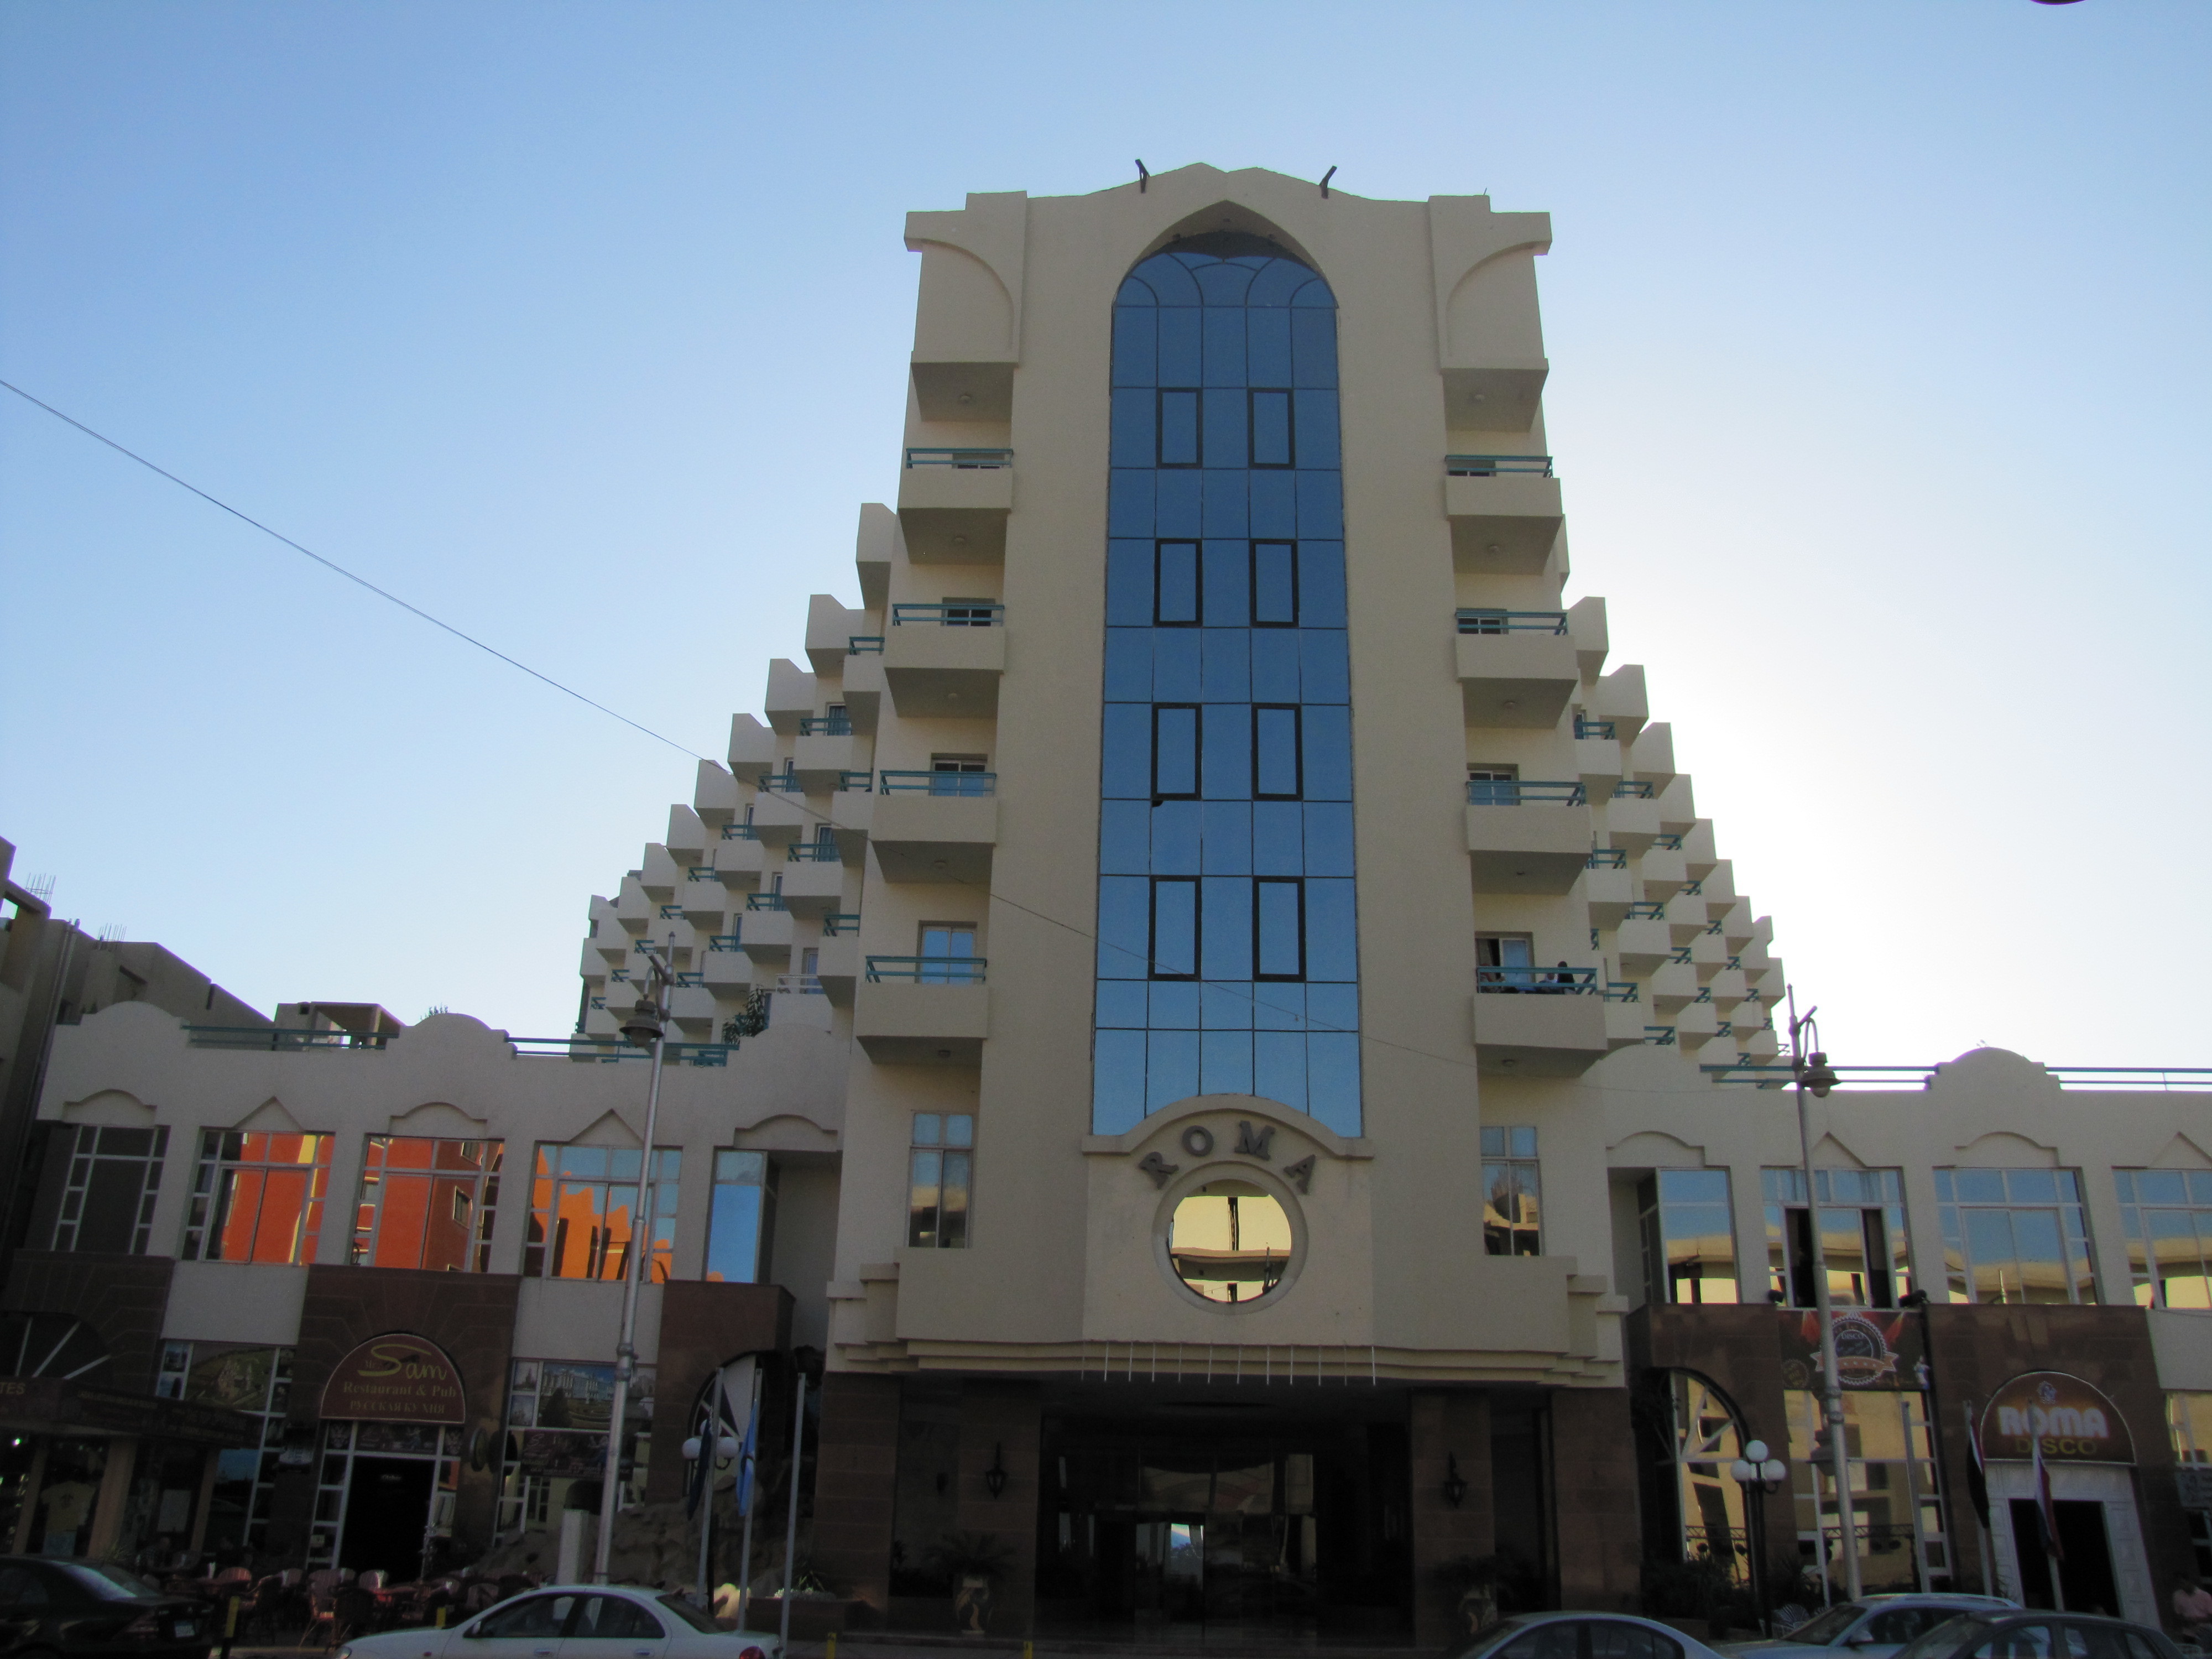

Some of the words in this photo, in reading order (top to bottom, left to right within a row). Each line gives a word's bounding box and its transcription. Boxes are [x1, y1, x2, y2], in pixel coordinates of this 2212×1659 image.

[1139, 1120, 1316, 1194] ROMA
[357, 1343, 447, 1381] Sam
[343, 1381, 412, 1395] Restaurant
[415, 1384, 426, 1396] &
[432, 1384, 457, 1397] Pub
[350, 1400, 401, 1412] РУССКАЯ
[1997, 1406, 2110, 1438] ROMA
[2016, 1437, 2098, 1455] DSCO
